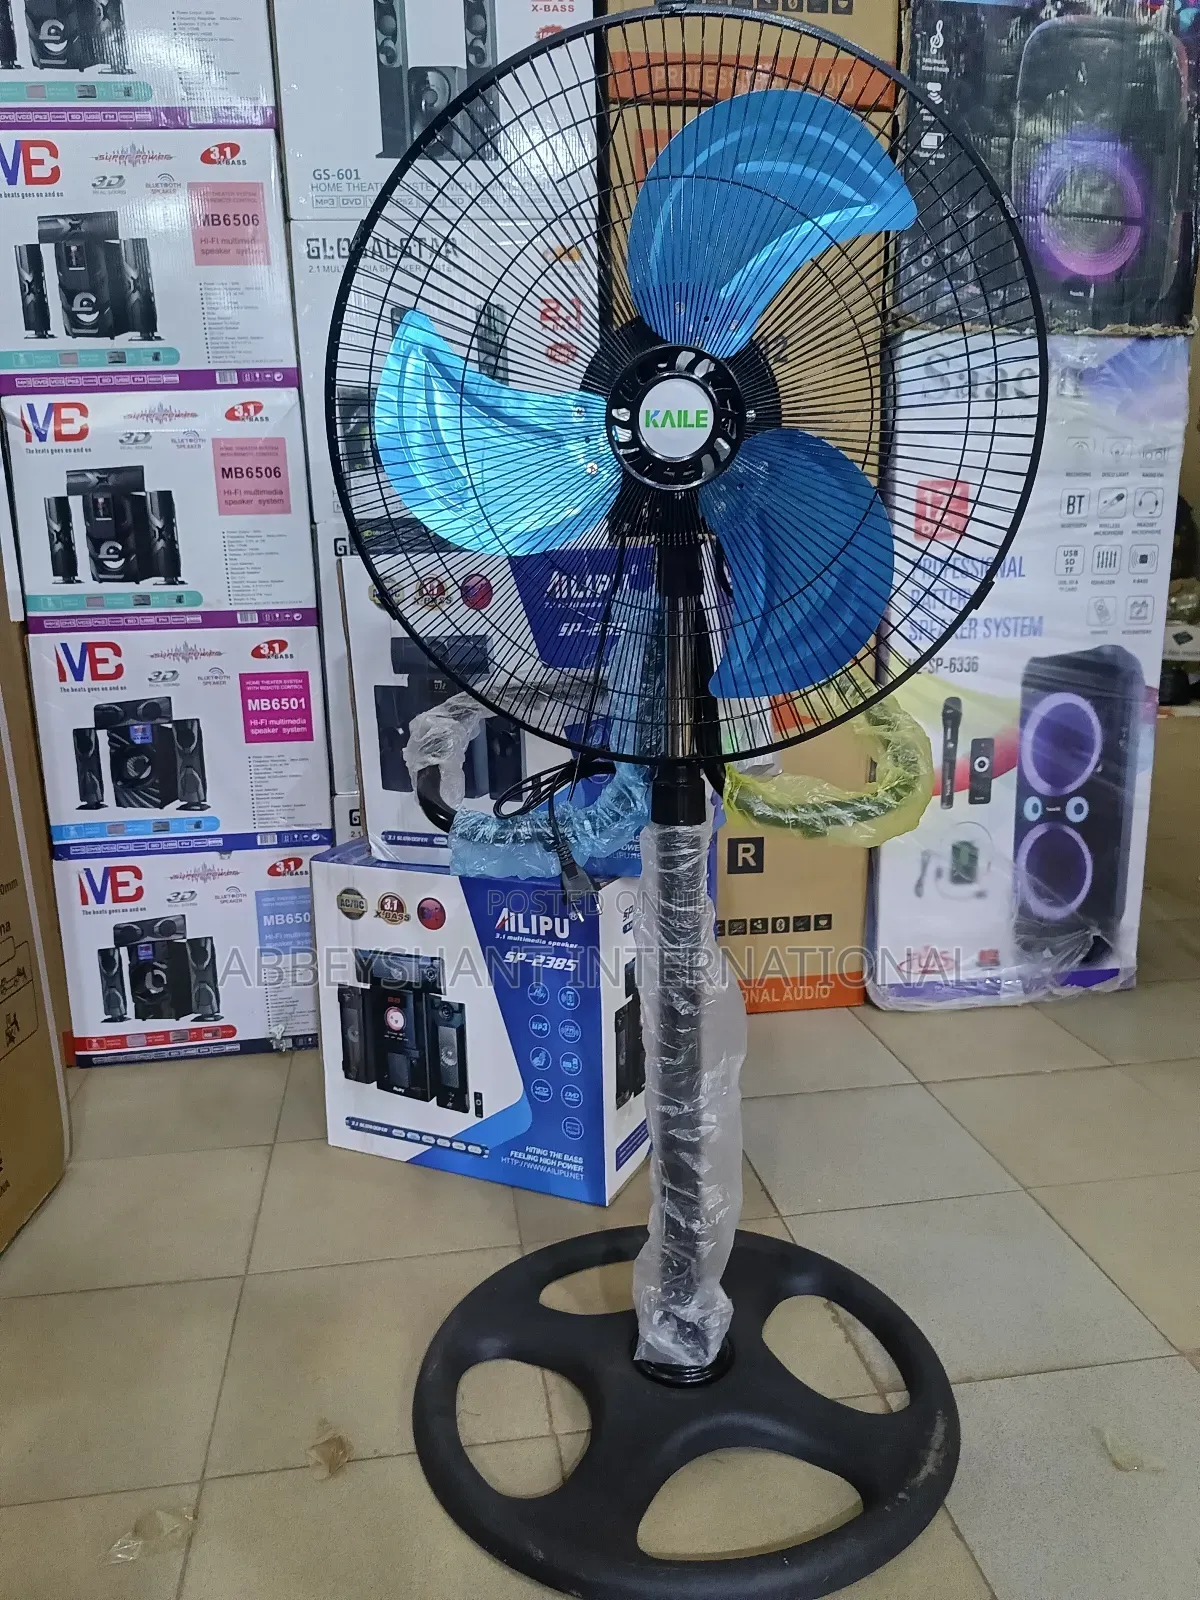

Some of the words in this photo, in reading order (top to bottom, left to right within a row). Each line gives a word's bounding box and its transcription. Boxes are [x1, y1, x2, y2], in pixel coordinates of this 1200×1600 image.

[532, 4, 575, 12] X-BASS
[209, 146, 233, 160] 3.1
[92, 174, 126, 188] 3D
[312, 168, 362, 180] GS-601
[311, 182, 342, 192] HOME
[346, 182, 385, 192] THEAT
[342, 198, 362, 206] DVD
[200, 214, 260, 226] MB6506
[306, 238, 459, 260] GLOALSTAR
[234, 404, 255, 417] 3.1
[645, 410, 708, 428] KAILE
[118, 432, 152, 446] 3D
[50, 448, 63, 456] goes
[221, 466, 282, 480] MB6506
[244, 488, 284, 496] multimedia
[224, 498, 254, 506] speaker
[258, 498, 284, 506] system
[1066, 494, 1085, 516] BT
[1063, 550, 1078, 558] USB
[913, 556, 1026, 580] PROFESSINAL
[1064, 558, 1076, 566] SD
[1065, 566, 1074, 574] TF
[983, 616, 1044, 639] SYSTEM
[260, 642, 280, 655] 3.1
[907, 656, 979, 674] -SP-6336
[148, 670, 180, 683] 3D
[247, 697, 306, 712] MB6501
[269, 718, 306, 726] multimedia
[250, 727, 278, 736] speaker
[282, 726, 308, 735] system
[622, 844, 640, 852] OWE
[737, 843, 757, 867] R
[276, 860, 296, 873] 3.1
[166, 890, 198, 904] 3D
[384, 898, 398, 912] 3.1
[263, 912, 310, 926] MB650
[495, 907, 571, 940] AILIPU
[507, 935, 546, 945] multimedia
[548, 940, 579, 950] speaker
[503, 950, 580, 972] SP-2385
[783, 984, 832, 1001] AUDIO
[532, 1021, 548, 1032] MP3
[510, 1150, 539, 1162] FEELING
[540, 1157, 556, 1166] HIGH
[558, 1160, 584, 1172] POWER
[525, 1146, 548, 1156] HITING
[550, 1150, 562, 1160] THE
[564, 1154, 584, 1164] BASS
